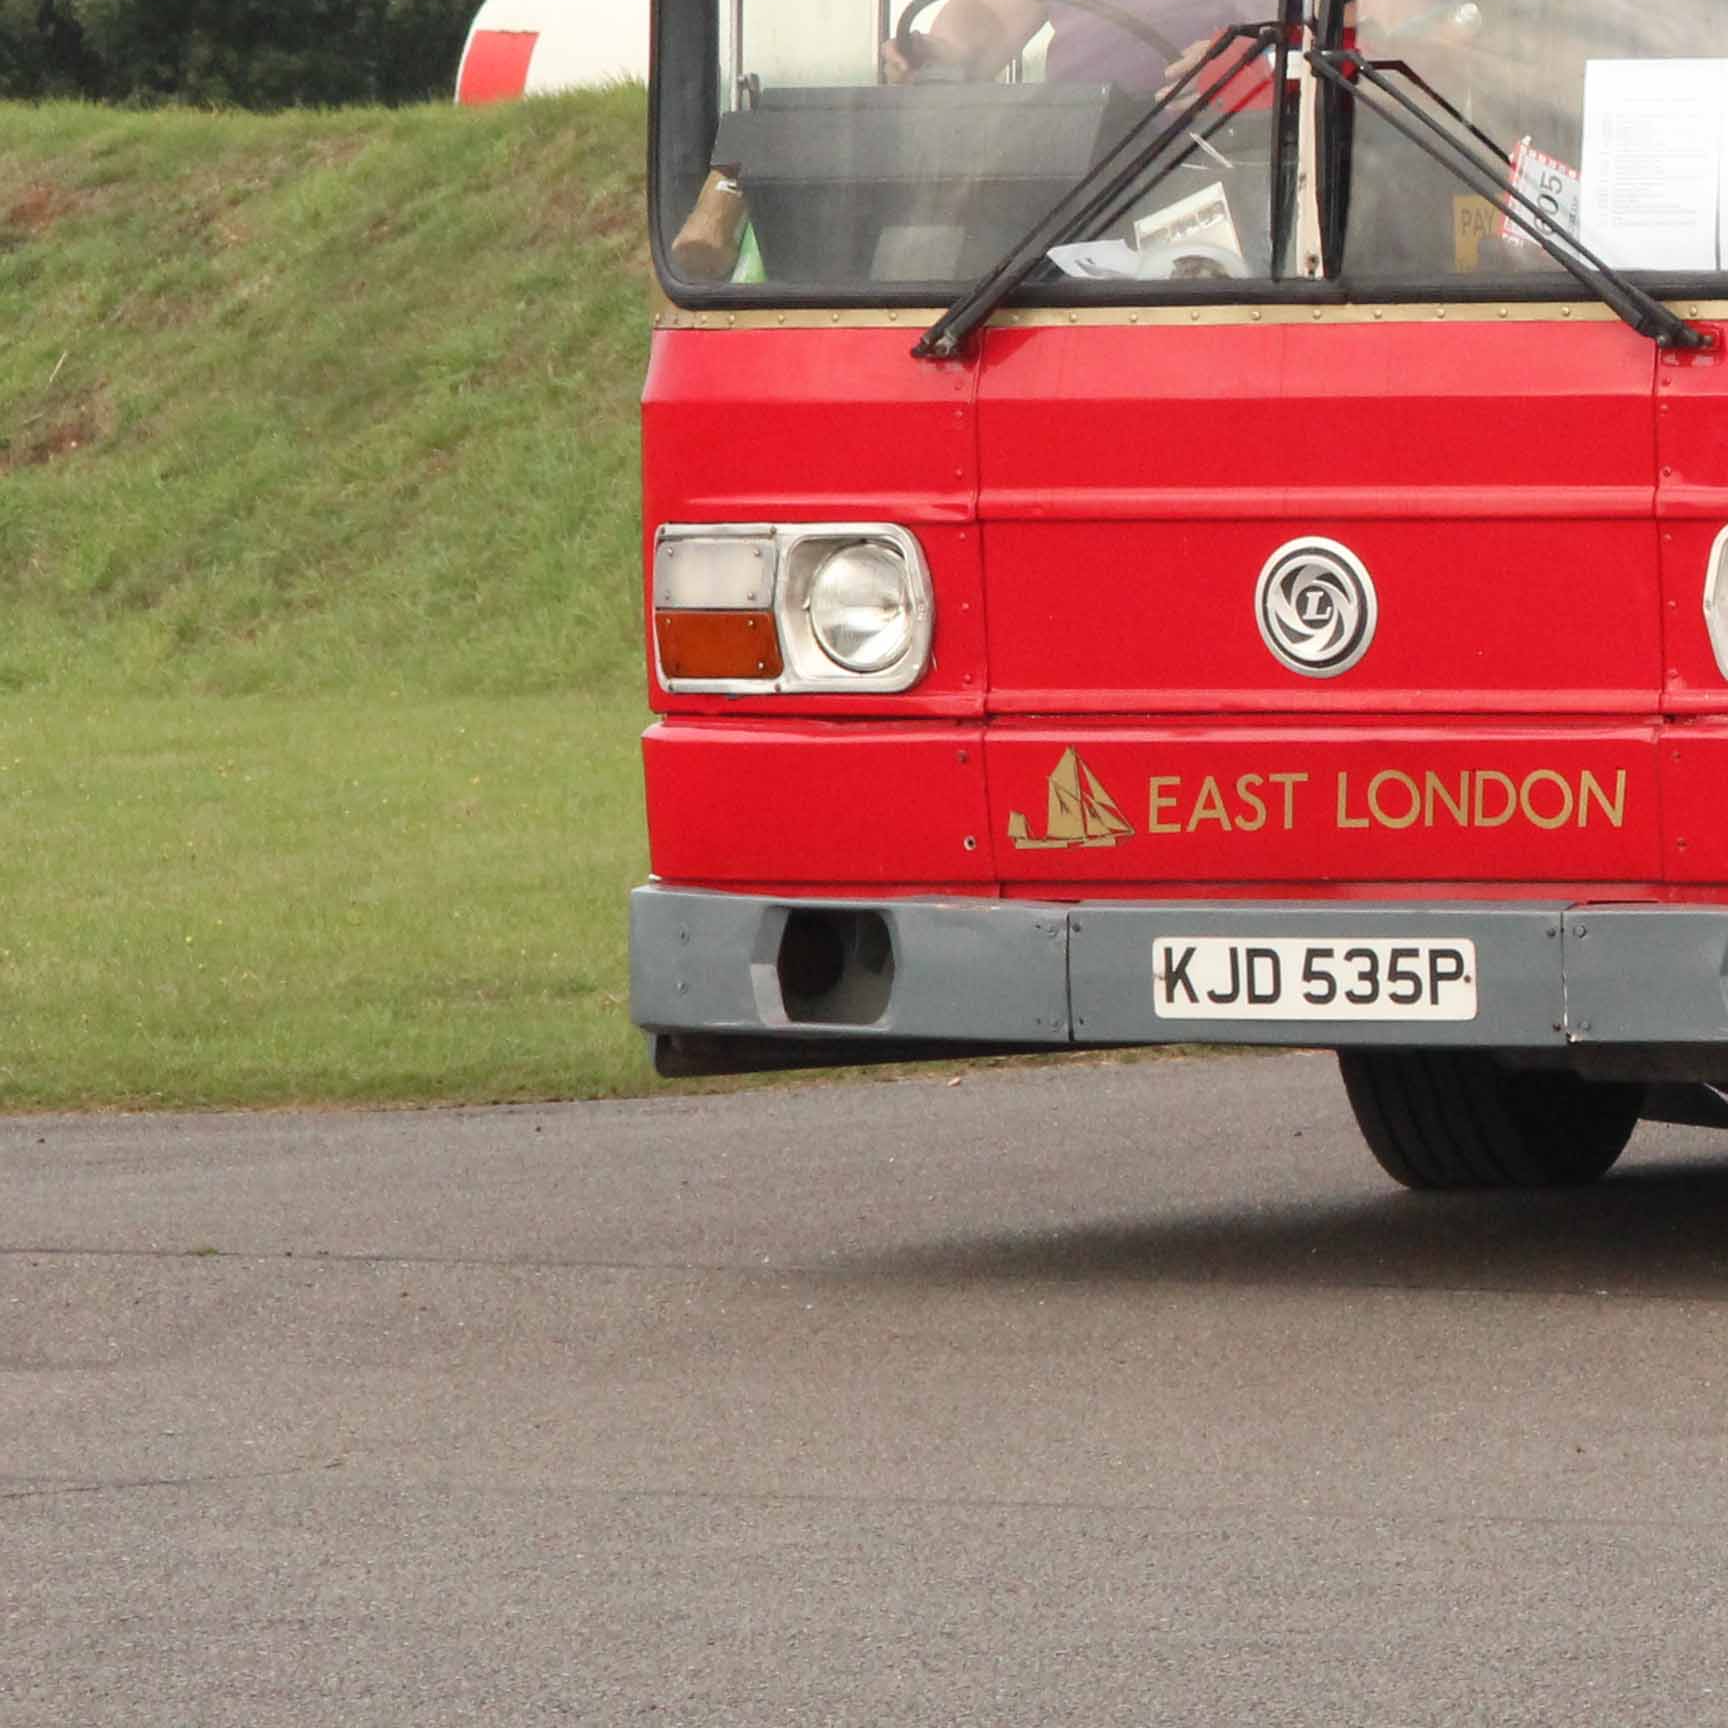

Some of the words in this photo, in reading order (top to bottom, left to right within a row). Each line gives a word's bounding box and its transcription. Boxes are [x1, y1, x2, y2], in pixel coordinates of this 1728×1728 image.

[1302, 591, 1332, 620] L
[1149, 772, 1309, 834] EAST
[1336, 769, 1627, 830] LONDON
[1163, 947, 1282, 1004] KJD
[1301, 947, 1465, 1006] 535P
